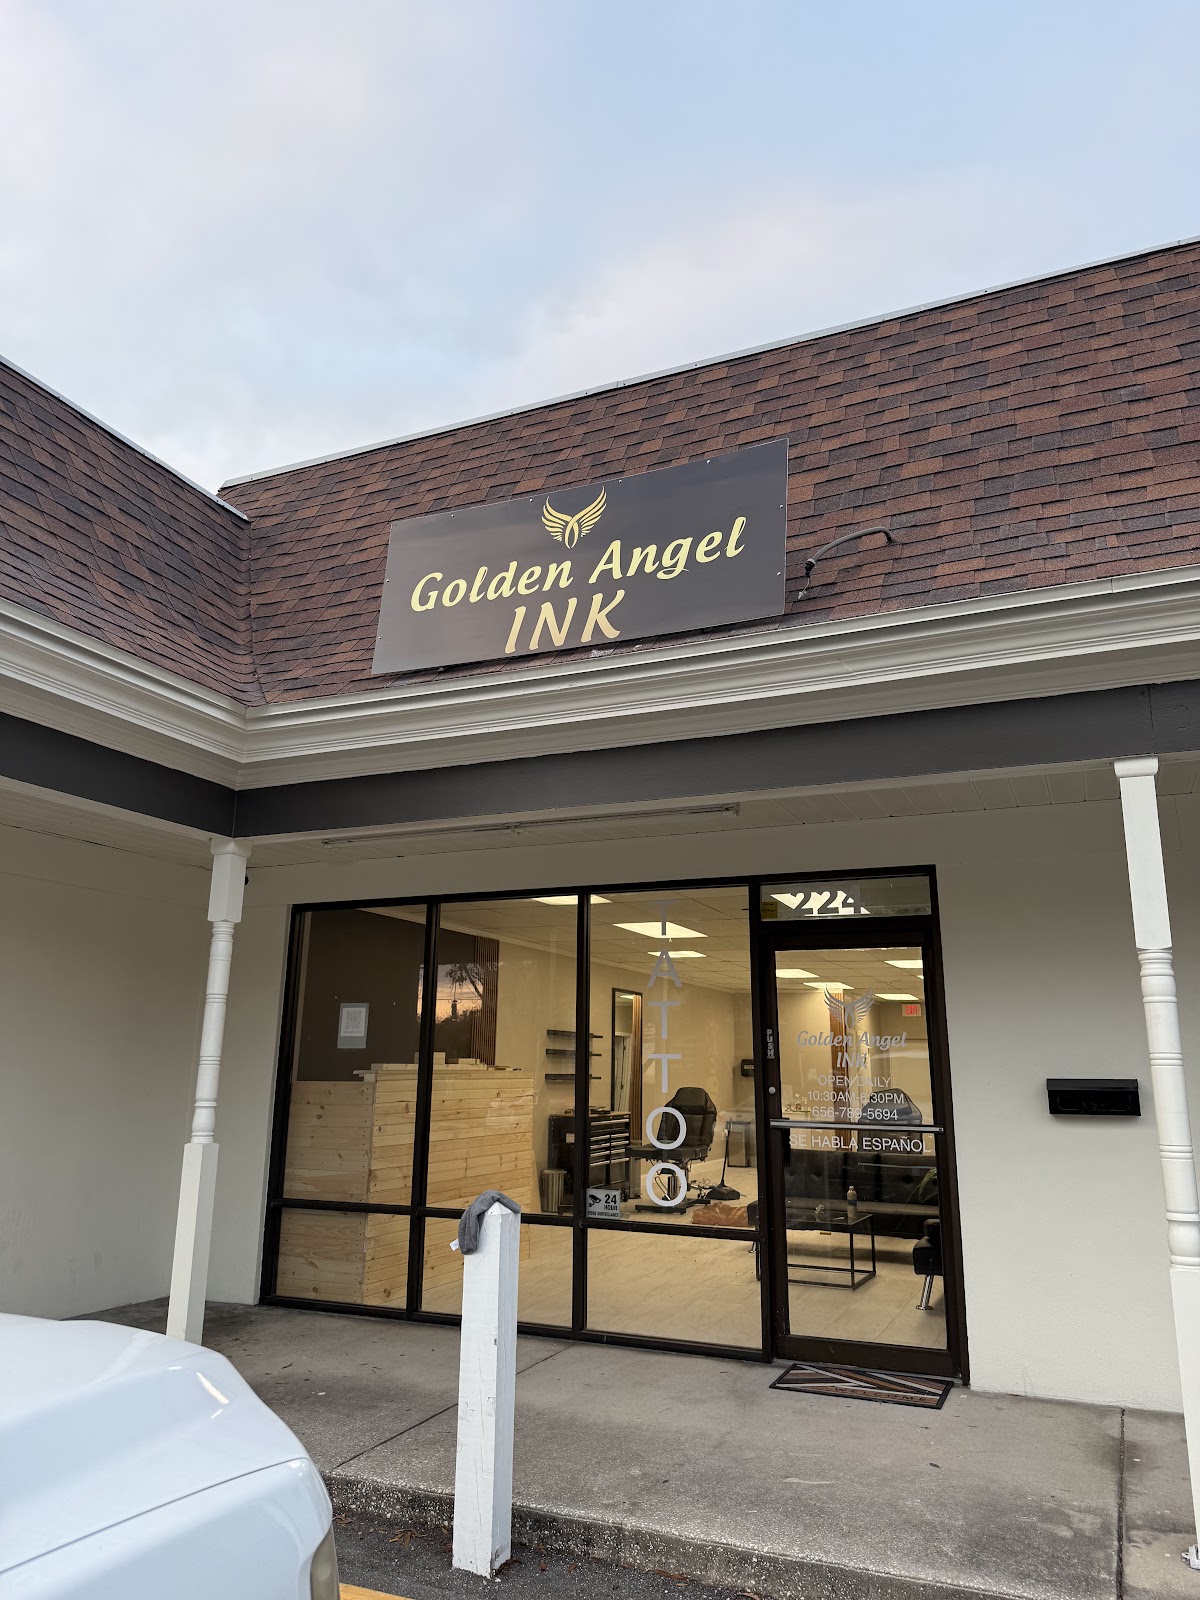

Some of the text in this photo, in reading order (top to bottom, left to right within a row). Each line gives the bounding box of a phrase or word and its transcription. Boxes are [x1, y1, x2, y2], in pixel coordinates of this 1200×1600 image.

[411, 516, 747, 612] Golden Angel
[504, 589, 625, 654] INK
[766, 1028, 775, 1057] PUSH
[796, 1030, 907, 1051] Golden Angel
[645, 899, 687, 1207] TATTOO
[836, 1051, 868, 1069] INK
[818, 1074, 891, 1088] OPEN DAILY
[807, 1090, 905, 1104] 10:30AM-6:30PM
[811, 1106, 899, 1120] 656-789-5694
[788, 1134, 932, 1153] SE HABLA ESPAÑOL
[604, 1193, 617, 1204] 24
[835, 1387, 926, 1401] WELCOME
